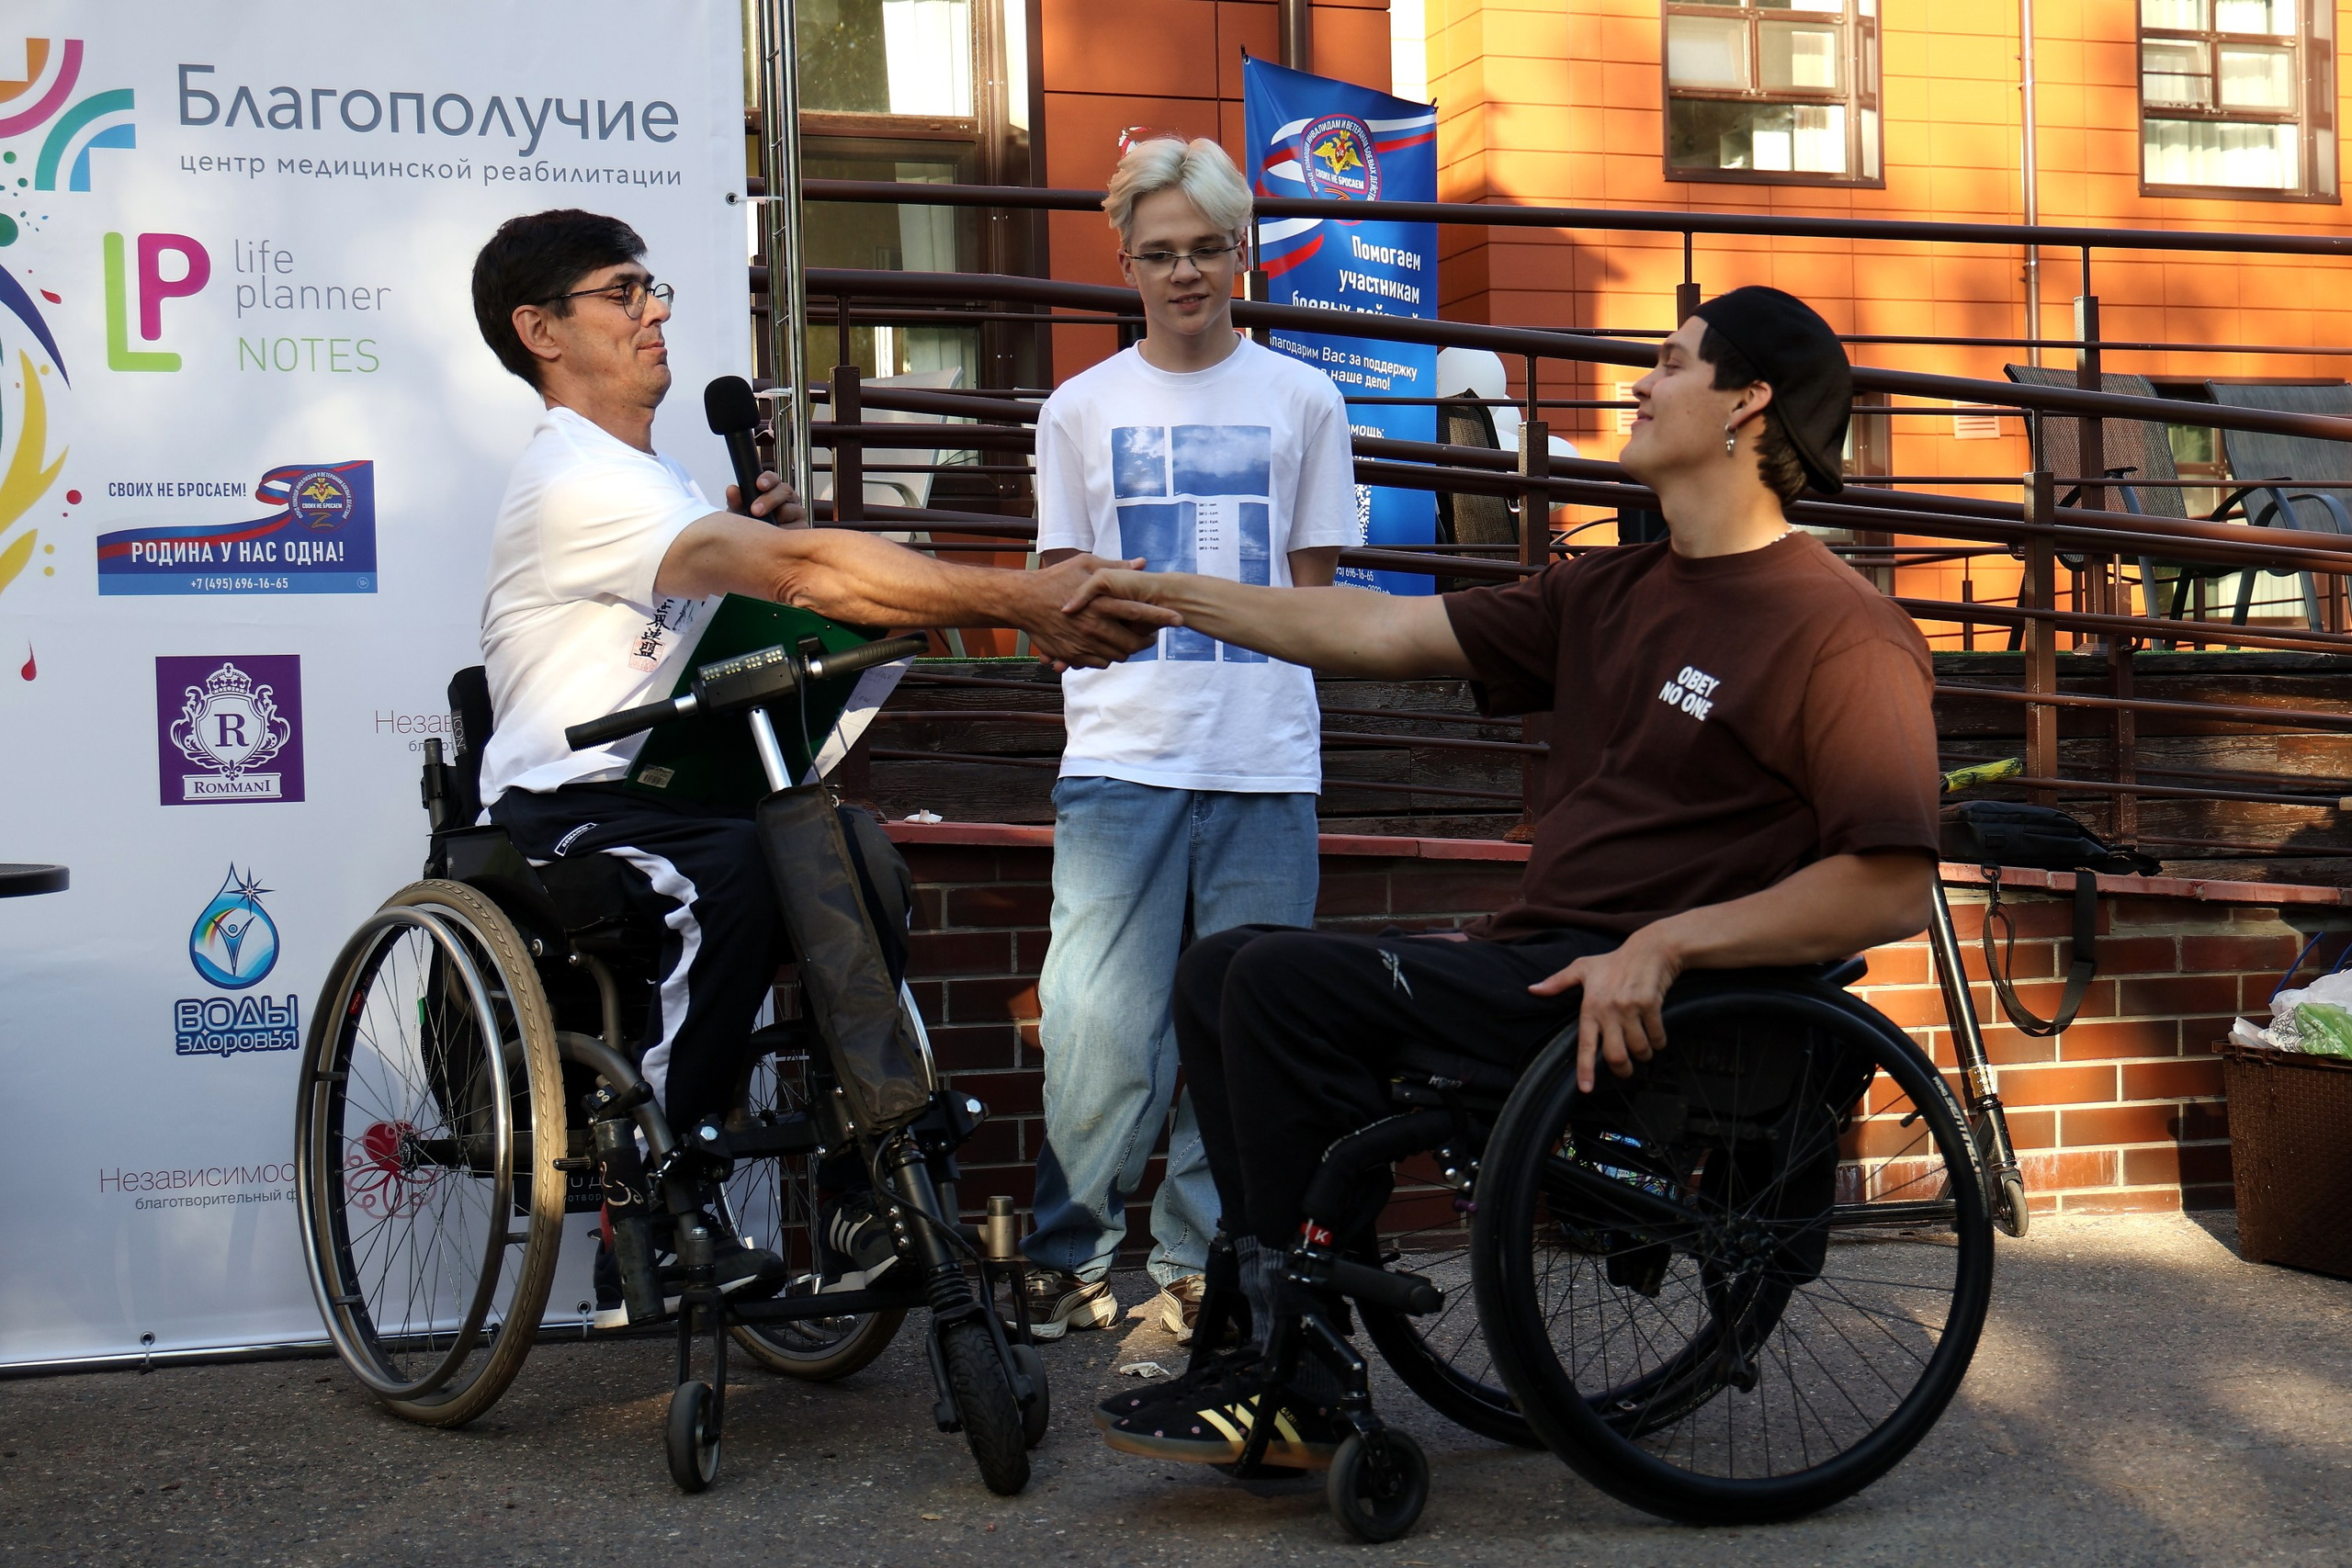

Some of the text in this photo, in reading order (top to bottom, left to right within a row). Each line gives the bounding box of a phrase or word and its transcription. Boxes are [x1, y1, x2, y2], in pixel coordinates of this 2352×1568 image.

[178, 63, 679, 157] Благополучие
[1306, 119, 1341, 144] ИНВАЛИДАМ
[1346, 120, 1369, 149] ВЕТЕРАНАМ
[1364, 147, 1377, 175] БОЕВЫХ
[181, 155, 681, 187] центр медицинской реабилитации
[1315, 168, 1364, 189] СВОИХ НЕ БРОСАЕМ
[235, 239, 294, 274] life
[1351, 235, 1420, 271] Помогаем
[236, 275, 391, 319] planner
[1339, 270, 1419, 304] участникам
[239, 337, 379, 373] NOTES
[1270, 332, 1418, 382] лагодарим Вас за поддержку
[1330, 368, 1363, 384] наше
[1364, 374, 1391, 390] дело!
[108, 482, 246, 497] СВОИХ НЕ БРОСАЕМ!
[131, 540, 345, 567] РОДИНА У НАС ОДНА!
[190, 577, 288, 592] +7 (495) 696-16-65
[1678, 666, 1721, 698] OBEY
[1657, 681, 1713, 722] NO ONE
[214, 713, 250, 747] R
[453, 716, 466, 748] ICON
[194, 779, 271, 795] ROMMANI
[175, 995, 298, 1032] ВОДЫ
[1932, 1076, 1978, 1167] PRIMO SENTINEL
[135, 1190, 281, 1210] благотворительный
